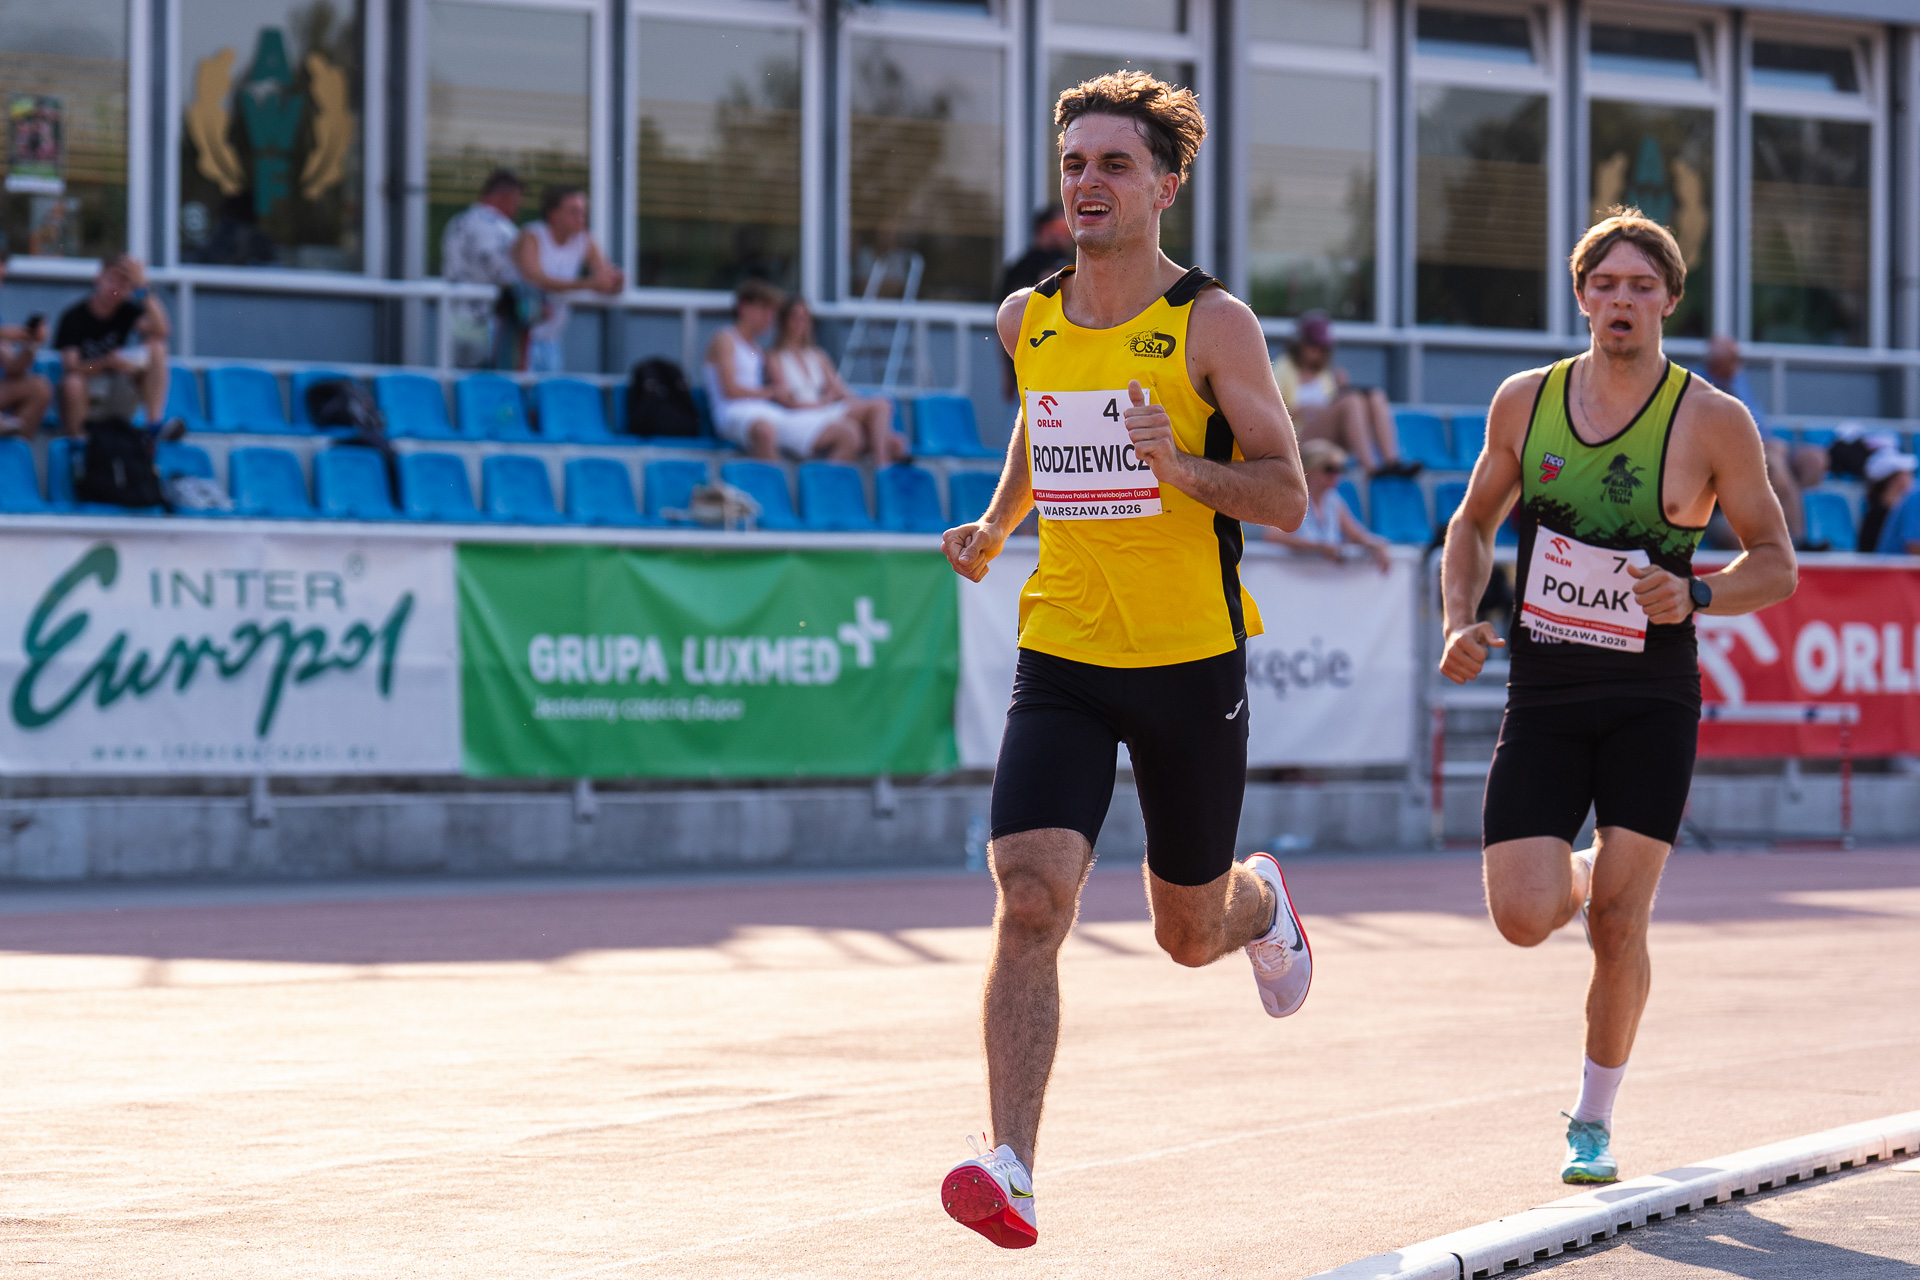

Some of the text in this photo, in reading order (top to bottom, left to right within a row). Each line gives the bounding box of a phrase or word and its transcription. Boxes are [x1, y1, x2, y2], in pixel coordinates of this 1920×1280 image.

[1135, 340, 1162, 354] OSA
[1103, 398, 1120, 422] 4
[1037, 419, 1062, 428] ORLEN
[1543, 453, 1565, 468] TICO
[1096, 490, 1133, 500] wielobojach
[1043, 504, 1142, 516] WARSZAWA 2026
[1544, 552, 1573, 568] ORLEN
[1612, 556, 1628, 574] 7
[150, 567, 346, 611] INTER
[1542, 574, 1631, 613] POLAK
[10, 541, 416, 740] Europol
[1534, 618, 1628, 648] WARSZAWA 2026
[529, 633, 843, 685] GRUPA LUXMED
[1793, 620, 1920, 694] ORL
